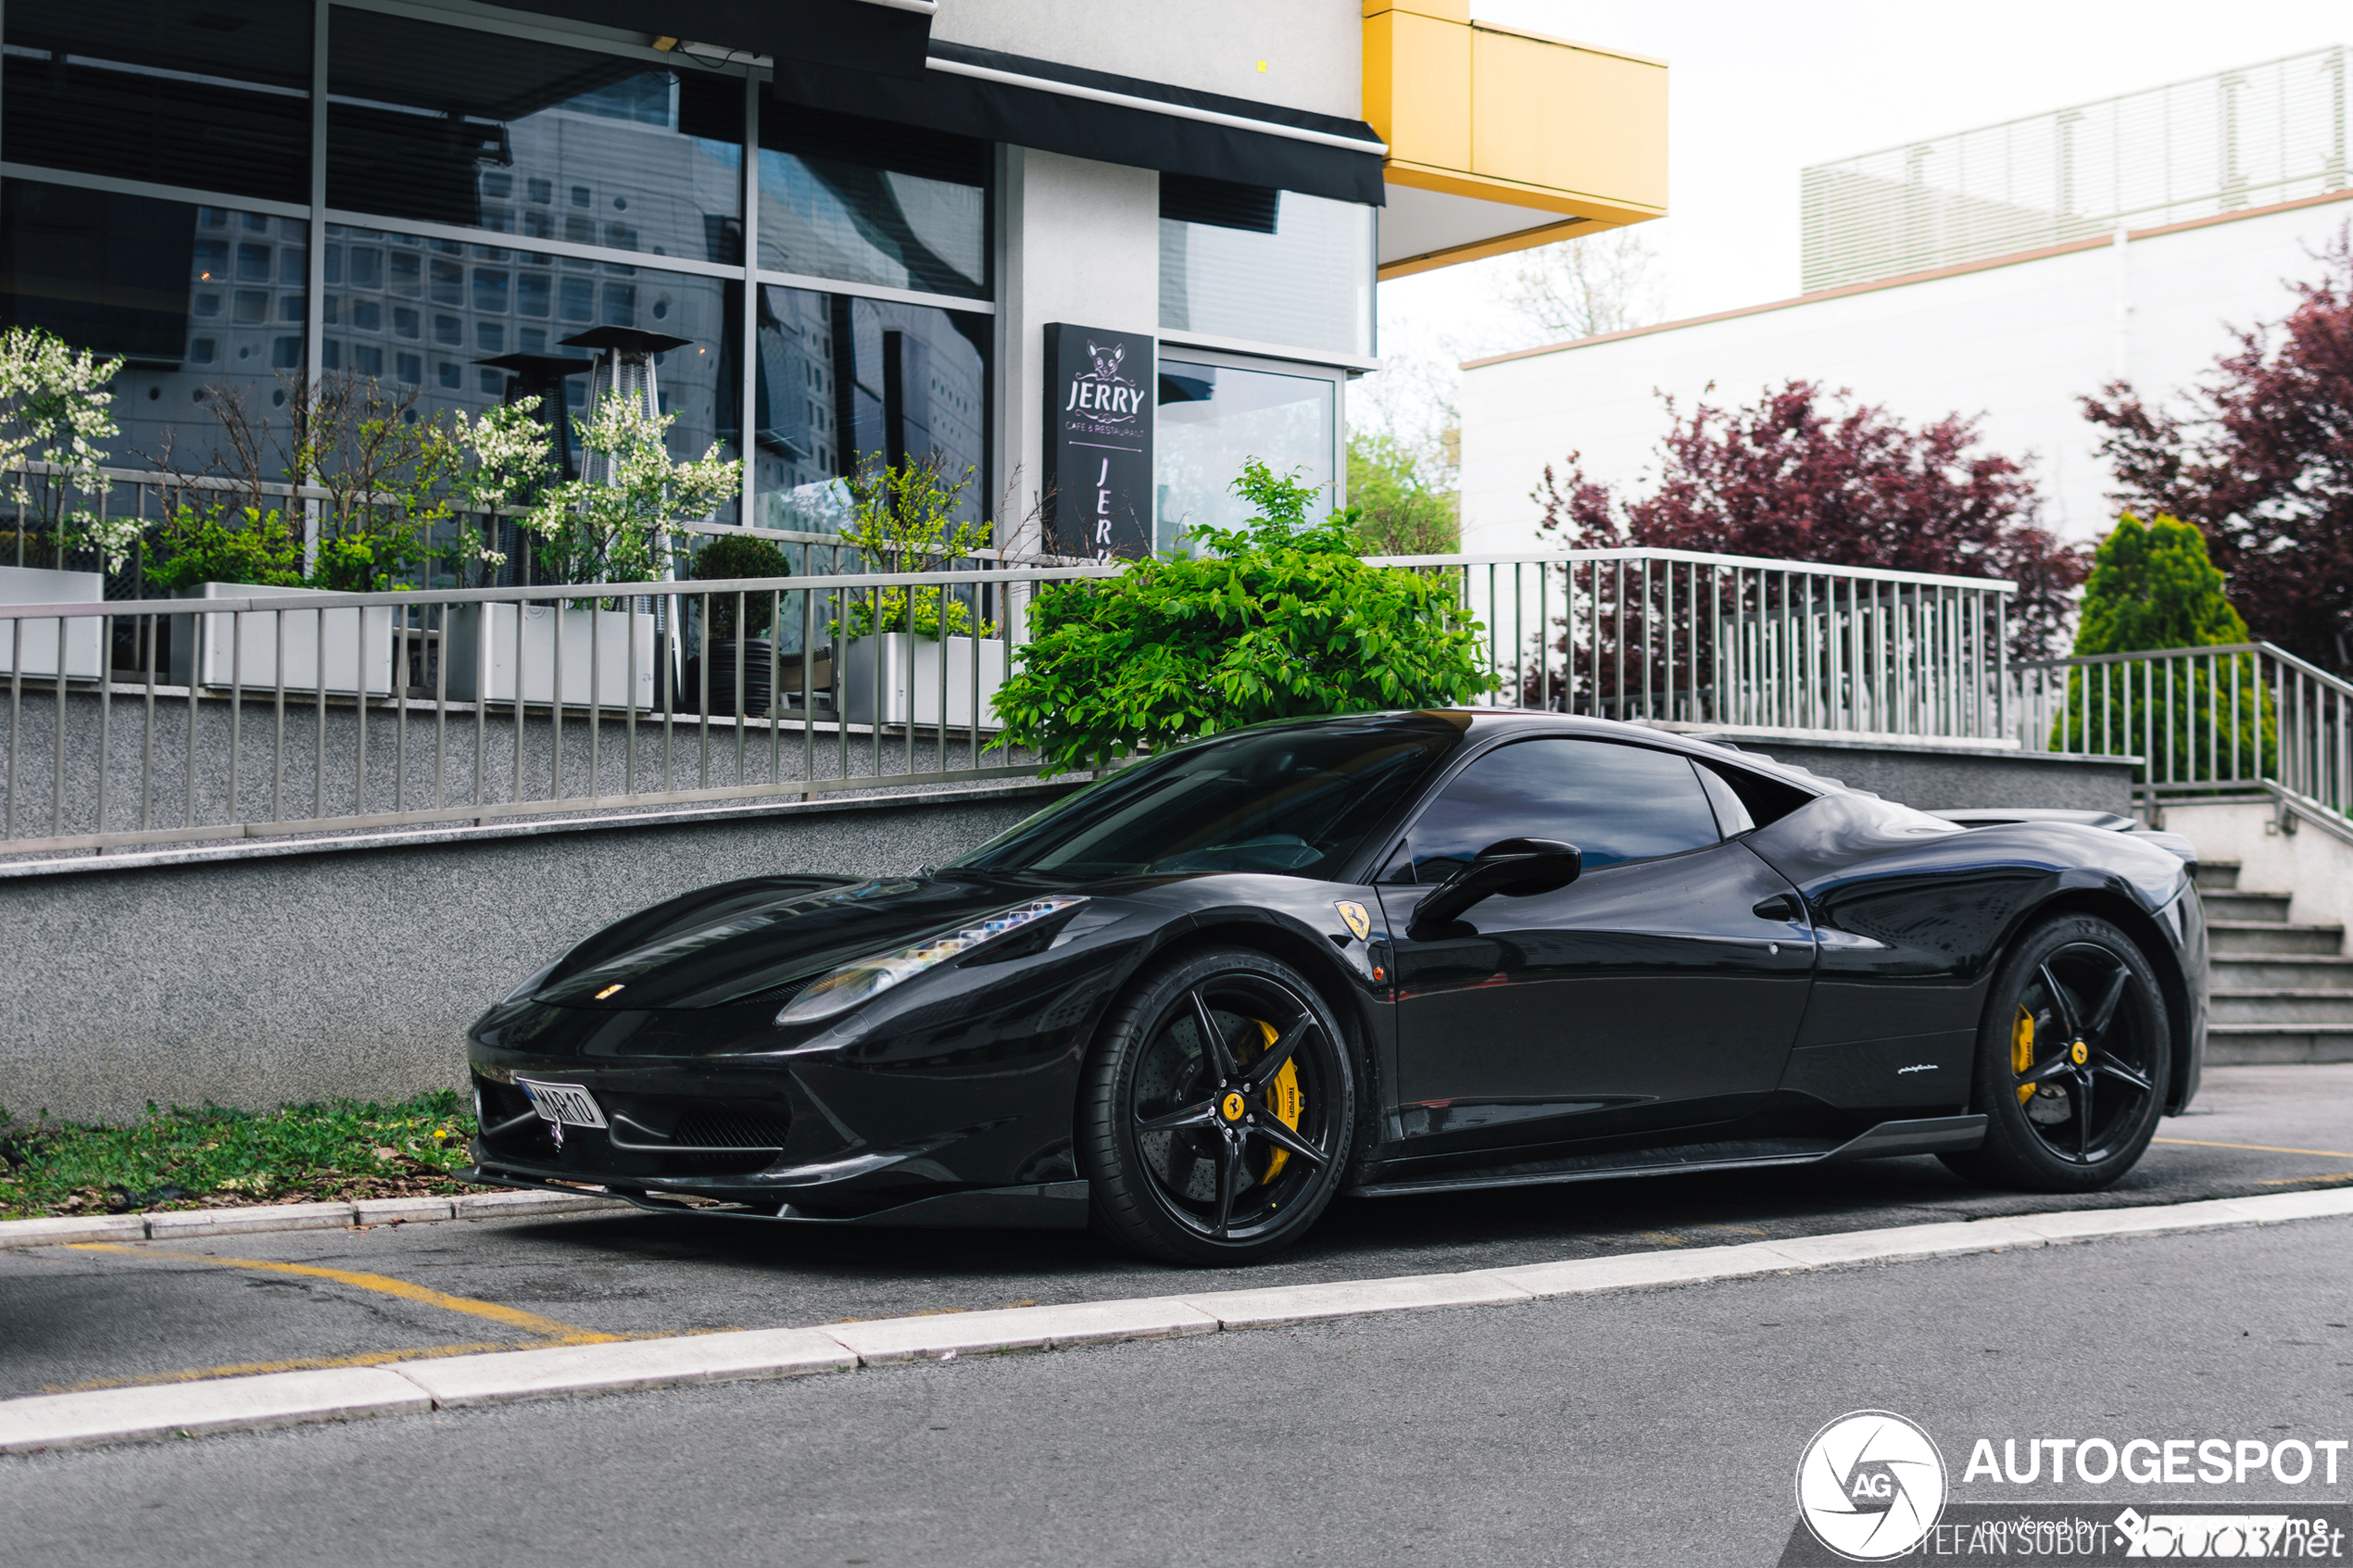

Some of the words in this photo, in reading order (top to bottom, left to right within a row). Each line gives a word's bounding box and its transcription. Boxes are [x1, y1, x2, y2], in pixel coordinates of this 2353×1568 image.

[1065, 380, 1145, 415] JERRY
[1065, 420, 1086, 433] CAFE
[1088, 424, 1093, 433] &
[1094, 424, 1145, 438] RESTAURANT
[1117, 1026, 1142, 1105] MICHELIN
